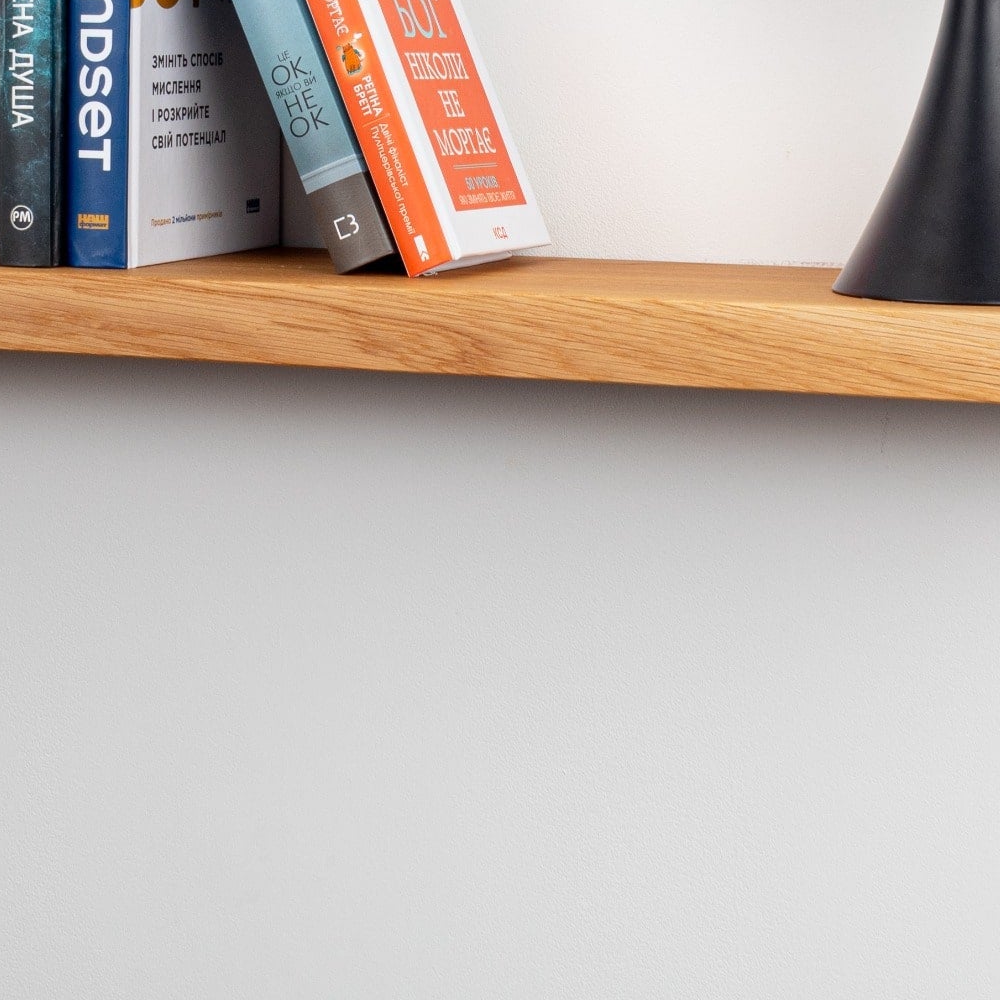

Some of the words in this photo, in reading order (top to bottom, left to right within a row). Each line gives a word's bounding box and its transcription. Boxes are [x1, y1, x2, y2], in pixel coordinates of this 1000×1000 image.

[152, 54, 188, 69] ЗМІНІТЬ
[190, 52, 224, 67] СПОСІБ
[277, 50, 290, 62] ЦЕ
[405, 53, 469, 80] НІКОЛИ
[9, 49, 34, 129] ДУША
[152, 79, 202, 96] МИСЛЕННЯ
[275, 82, 301, 99] ЯКЩО
[303, 76, 317, 87] ВИ
[353, 84, 373, 117] БРЕТТ
[362, 75, 384, 117] РЕГІНА
[152, 108, 155, 123] І
[158, 102, 210, 122] РОЗКРИЙТЕ
[284, 88, 317, 117] НЕ
[438, 90, 465, 118] НЕ
[290, 107, 330, 137] ОК
[152, 131, 173, 150] СВІЙ
[176, 129, 226, 147] ПОТЕНЦІАЛ
[433, 127, 497, 156] МОРГАЄ
[378, 122, 394, 149] Двічі
[388, 146, 409, 187] фіналіст
[370, 126, 405, 207] Пулітцерівської
[398, 202, 416, 236] премії
